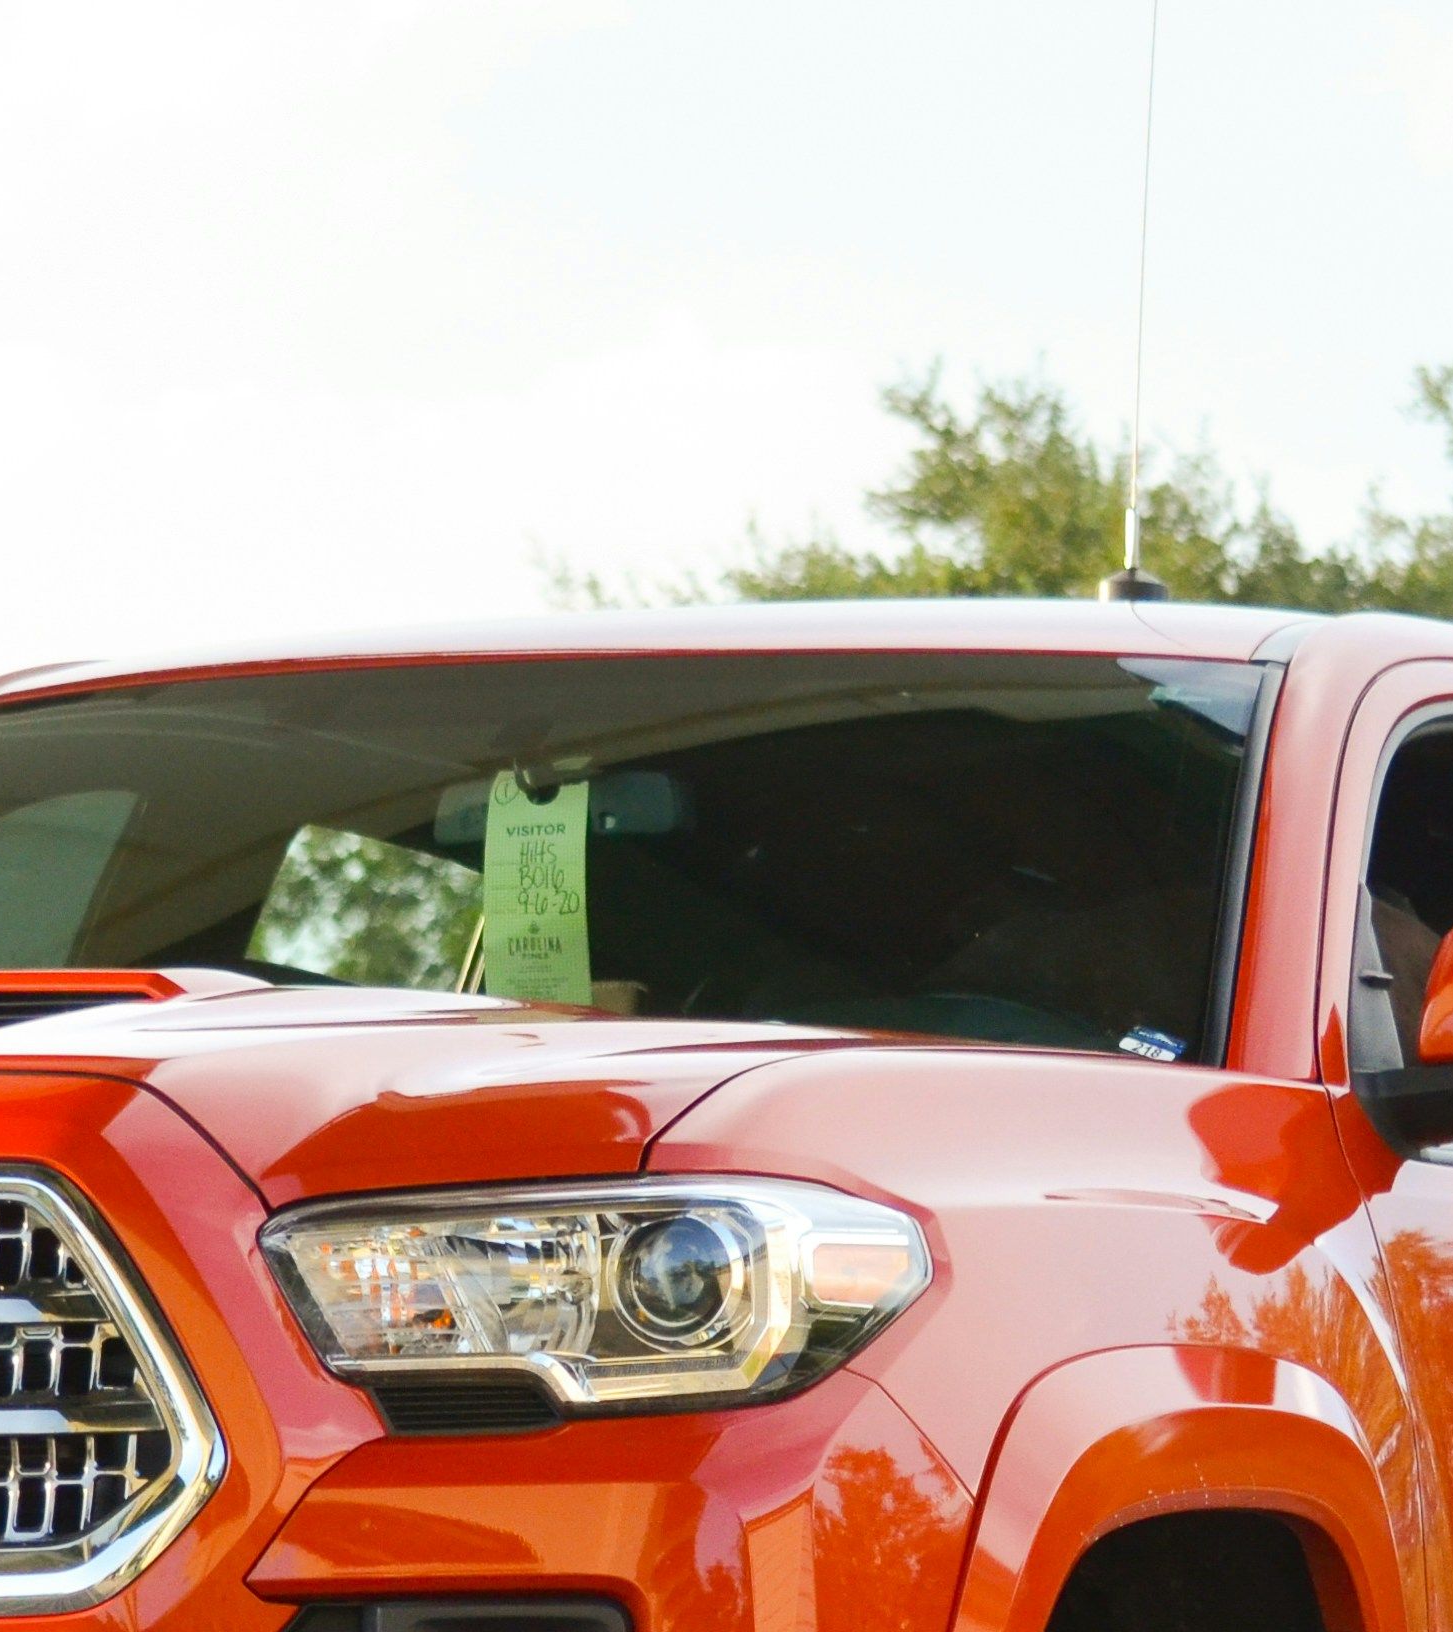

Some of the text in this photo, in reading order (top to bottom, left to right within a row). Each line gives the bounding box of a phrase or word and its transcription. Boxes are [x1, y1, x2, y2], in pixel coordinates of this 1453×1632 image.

[506, 823, 566, 837] VISITOR
[508, 936, 563, 957] CAROLINA
[1132, 1042, 1163, 1058] 218
